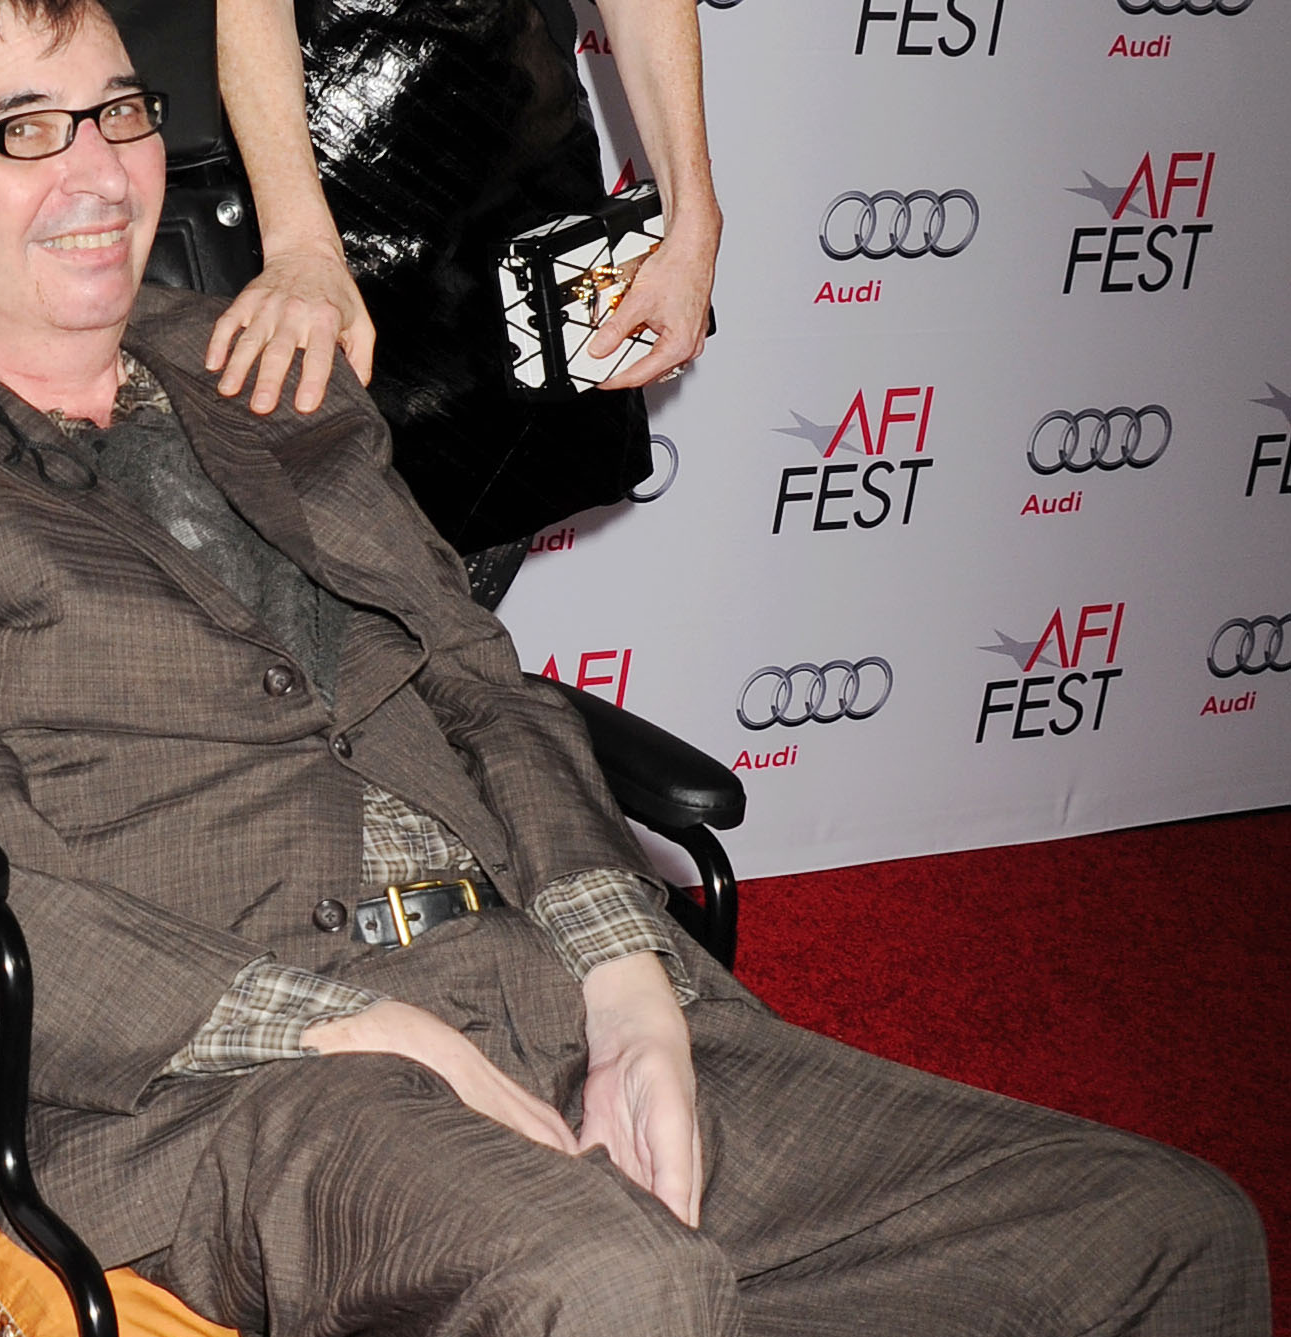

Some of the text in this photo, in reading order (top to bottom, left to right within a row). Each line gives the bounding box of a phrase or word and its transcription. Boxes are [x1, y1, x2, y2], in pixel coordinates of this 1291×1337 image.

[1108, 35, 1169, 57] Audi
[1113, 152, 1215, 220] AFI
[1063, 225, 1213, 293] FEST
[815, 282, 880, 303] Audi
[824, 387, 934, 458] AFI
[773, 459, 933, 534] FEST
[1021, 493, 1080, 515] Audi
[528, 528, 576, 553] udi
[1024, 603, 1125, 672] AFI
[976, 669, 1122, 743] FEST
[1201, 695, 1254, 715] Audi
[733, 747, 796, 771] Audi
